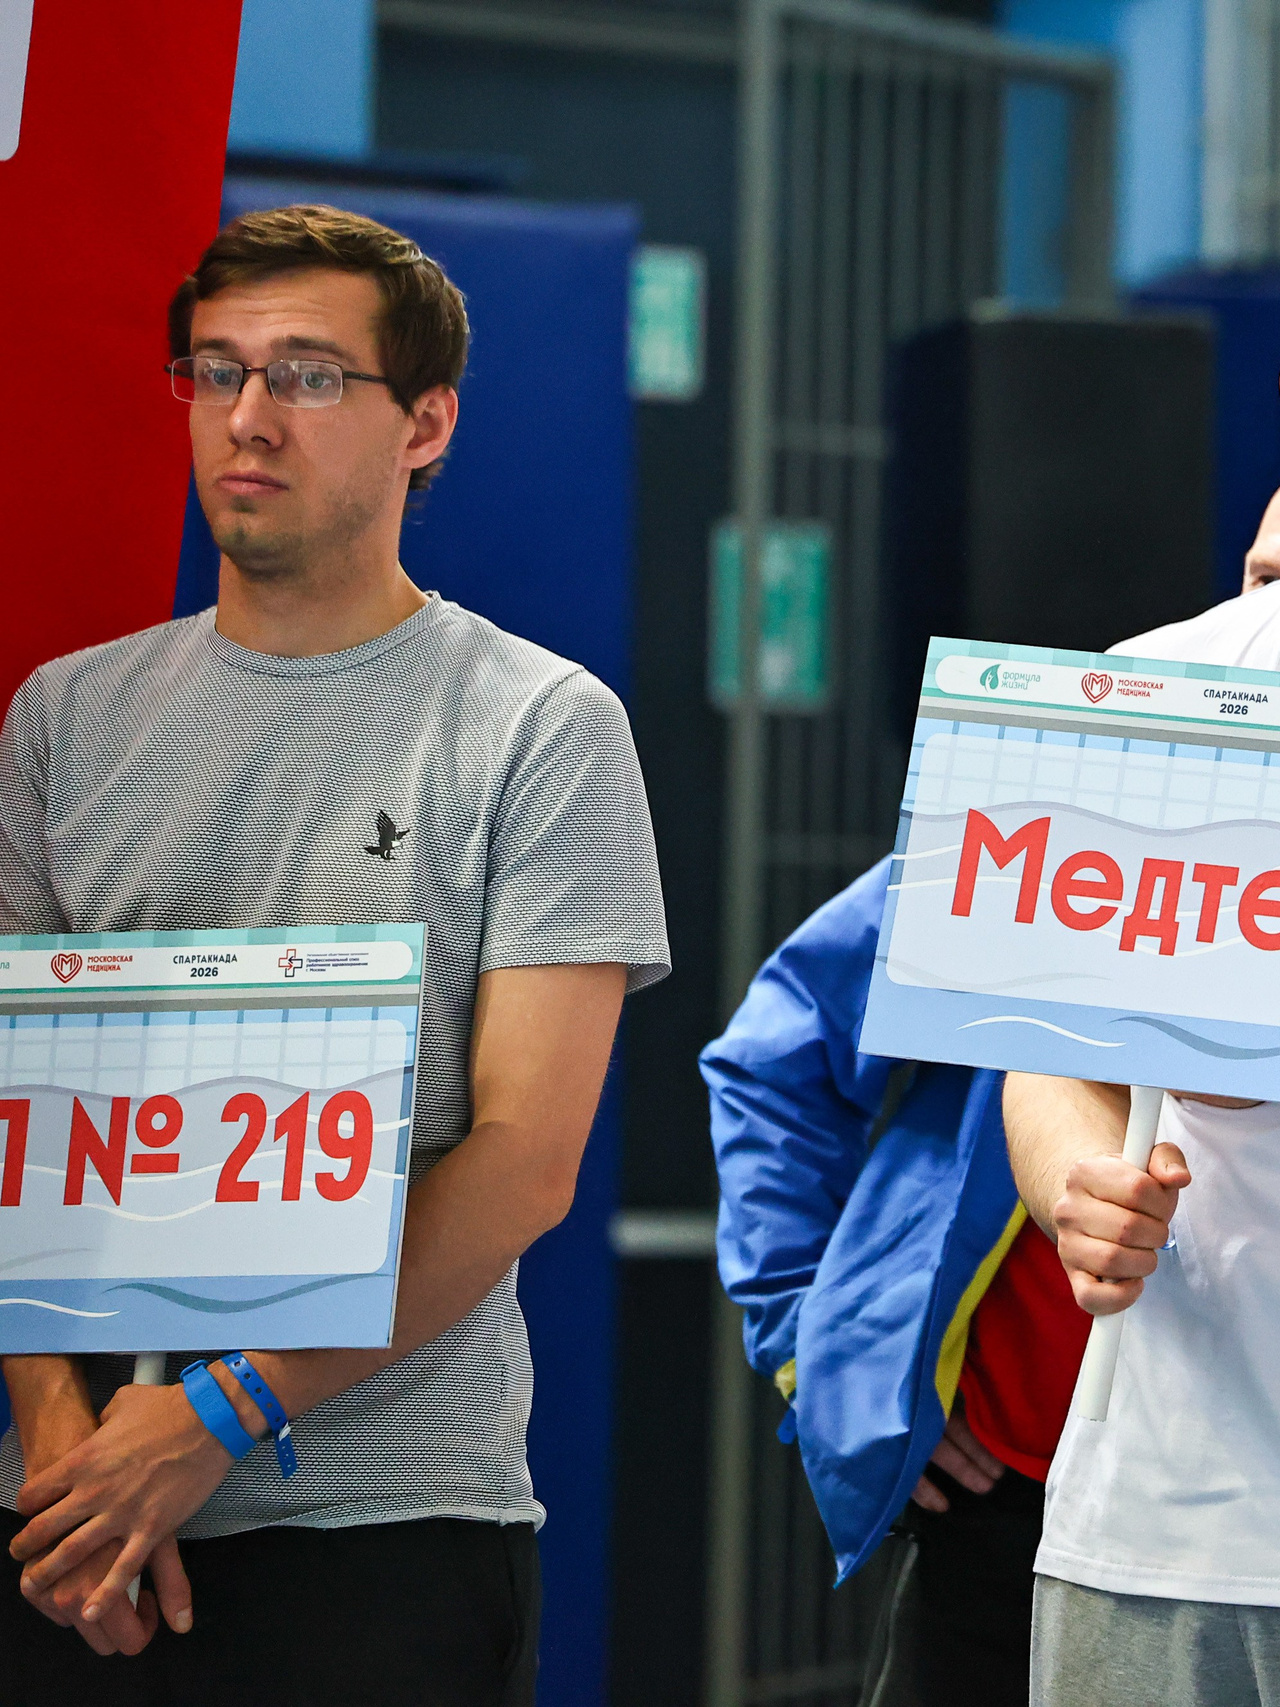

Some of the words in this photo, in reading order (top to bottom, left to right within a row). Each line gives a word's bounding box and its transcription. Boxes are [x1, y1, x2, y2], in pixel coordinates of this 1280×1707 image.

[1002, 671, 1041, 683] формула
[1001, 680, 1029, 690] жизни
[1118, 679, 1164, 690] МОСКОВСКАЯ
[1117, 688, 1151, 698] МЕДИЦИНА
[1203, 689, 1269, 703] СПАРТАКИАДА
[1219, 703, 1249, 715] 2026
[88, 955, 134, 963] МОСКОВСКАЯ
[172, 953, 238, 964] СПАРТАКИАДА
[87, 964, 121, 972] МЕДИЦИНА
[190, 966, 219, 978] 2026
[63, 1095, 184, 1207] №
[214, 1090, 374, 1203] 219
